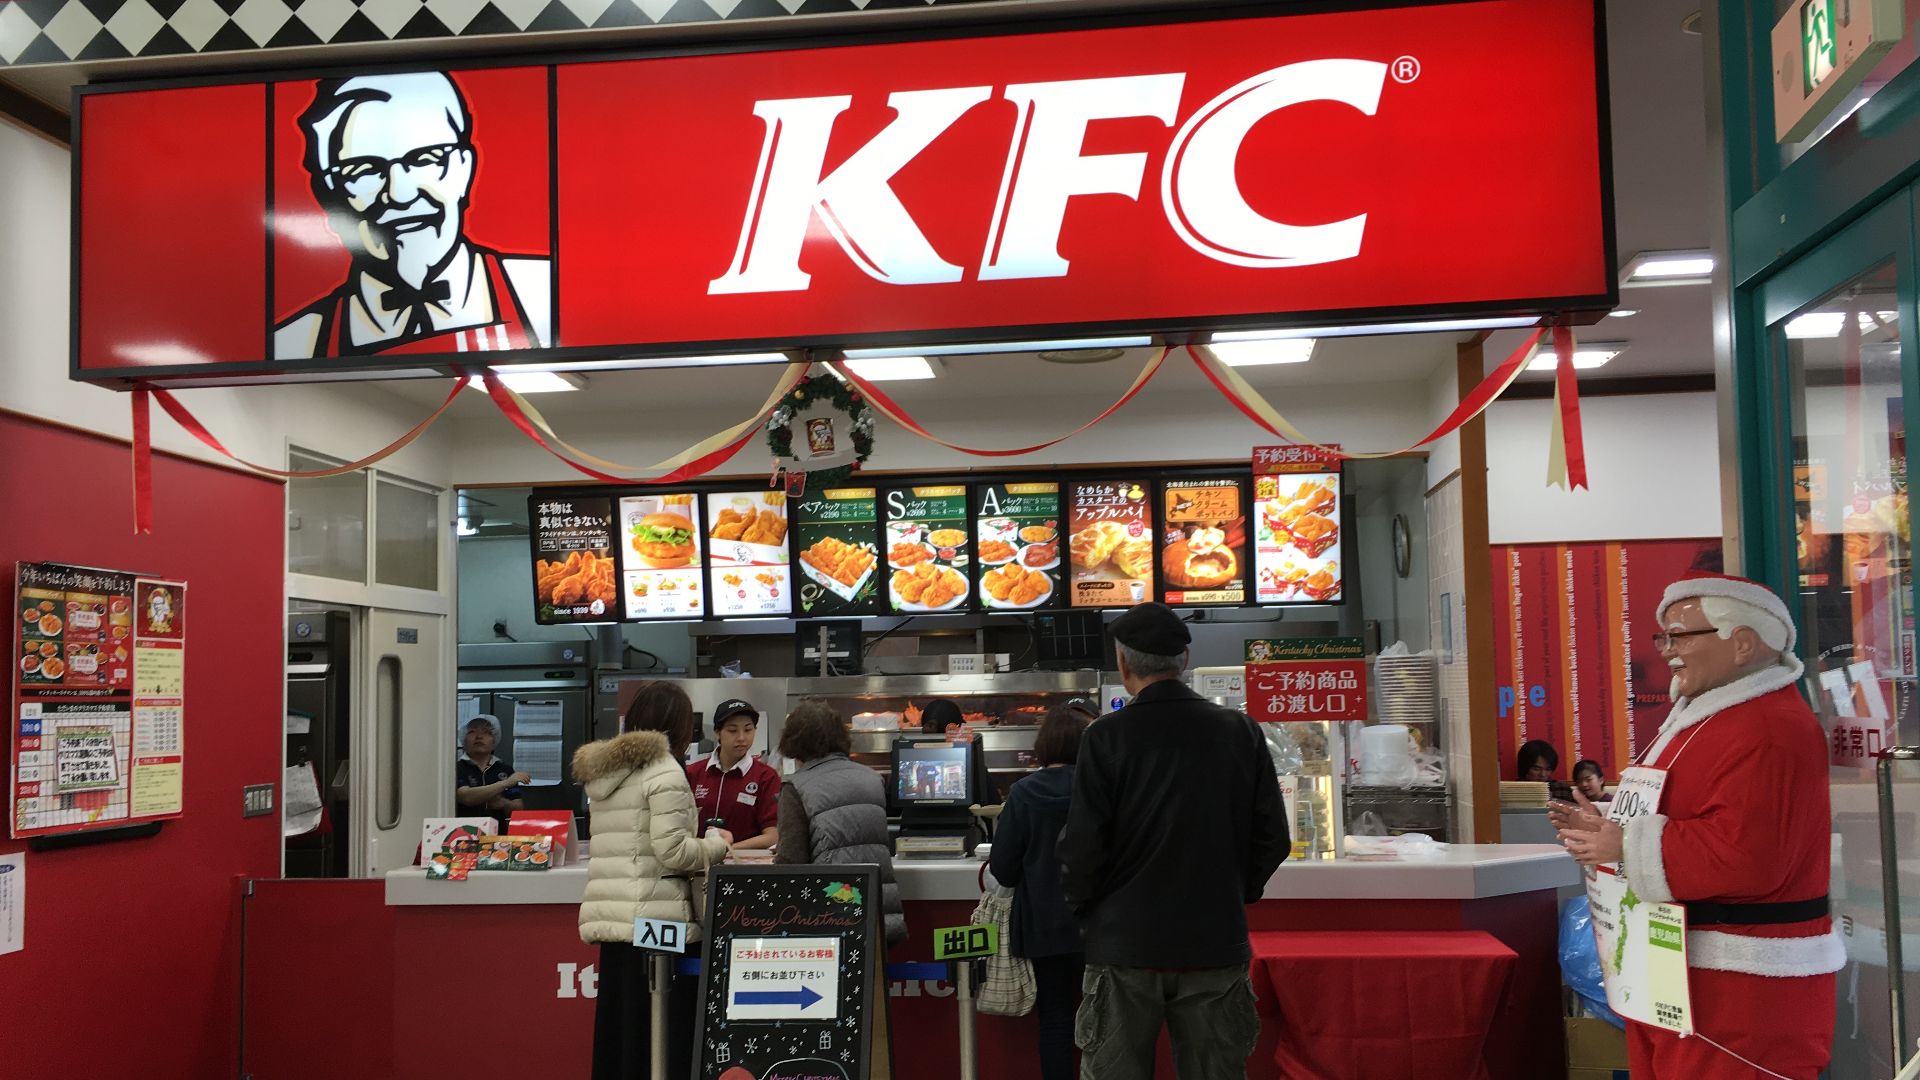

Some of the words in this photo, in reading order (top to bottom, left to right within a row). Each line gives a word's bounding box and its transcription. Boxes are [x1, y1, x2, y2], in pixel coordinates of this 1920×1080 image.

[706, 58, 1388, 296] KFC
[978, 487, 1003, 515] A
[1077, 485, 1114, 495] なめらか
[538, 502, 573, 515] 本物は
[887, 490, 906, 520] S
[1075, 505, 1144, 520] アップルパイ
[539, 515, 607, 529] 真似できない。
[1274, 643, 1315, 657] Kentucky
[1314, 642, 1362, 655] Christmas
[1258, 669, 1358, 691] ご予約商品
[1267, 694, 1346, 714] お渡し口
[1833, 725, 1881, 758] 非常口
[1613, 790, 1650, 817] 100%
[720, 905, 782, 934] Merry
[779, 905, 863, 927] Christmas
[641, 921, 678, 948] 入口
[943, 927, 989, 956] 出口
[736, 949, 834, 960] ご予約されているお客様
[742, 970, 825, 981] 右側にお並び下さい
